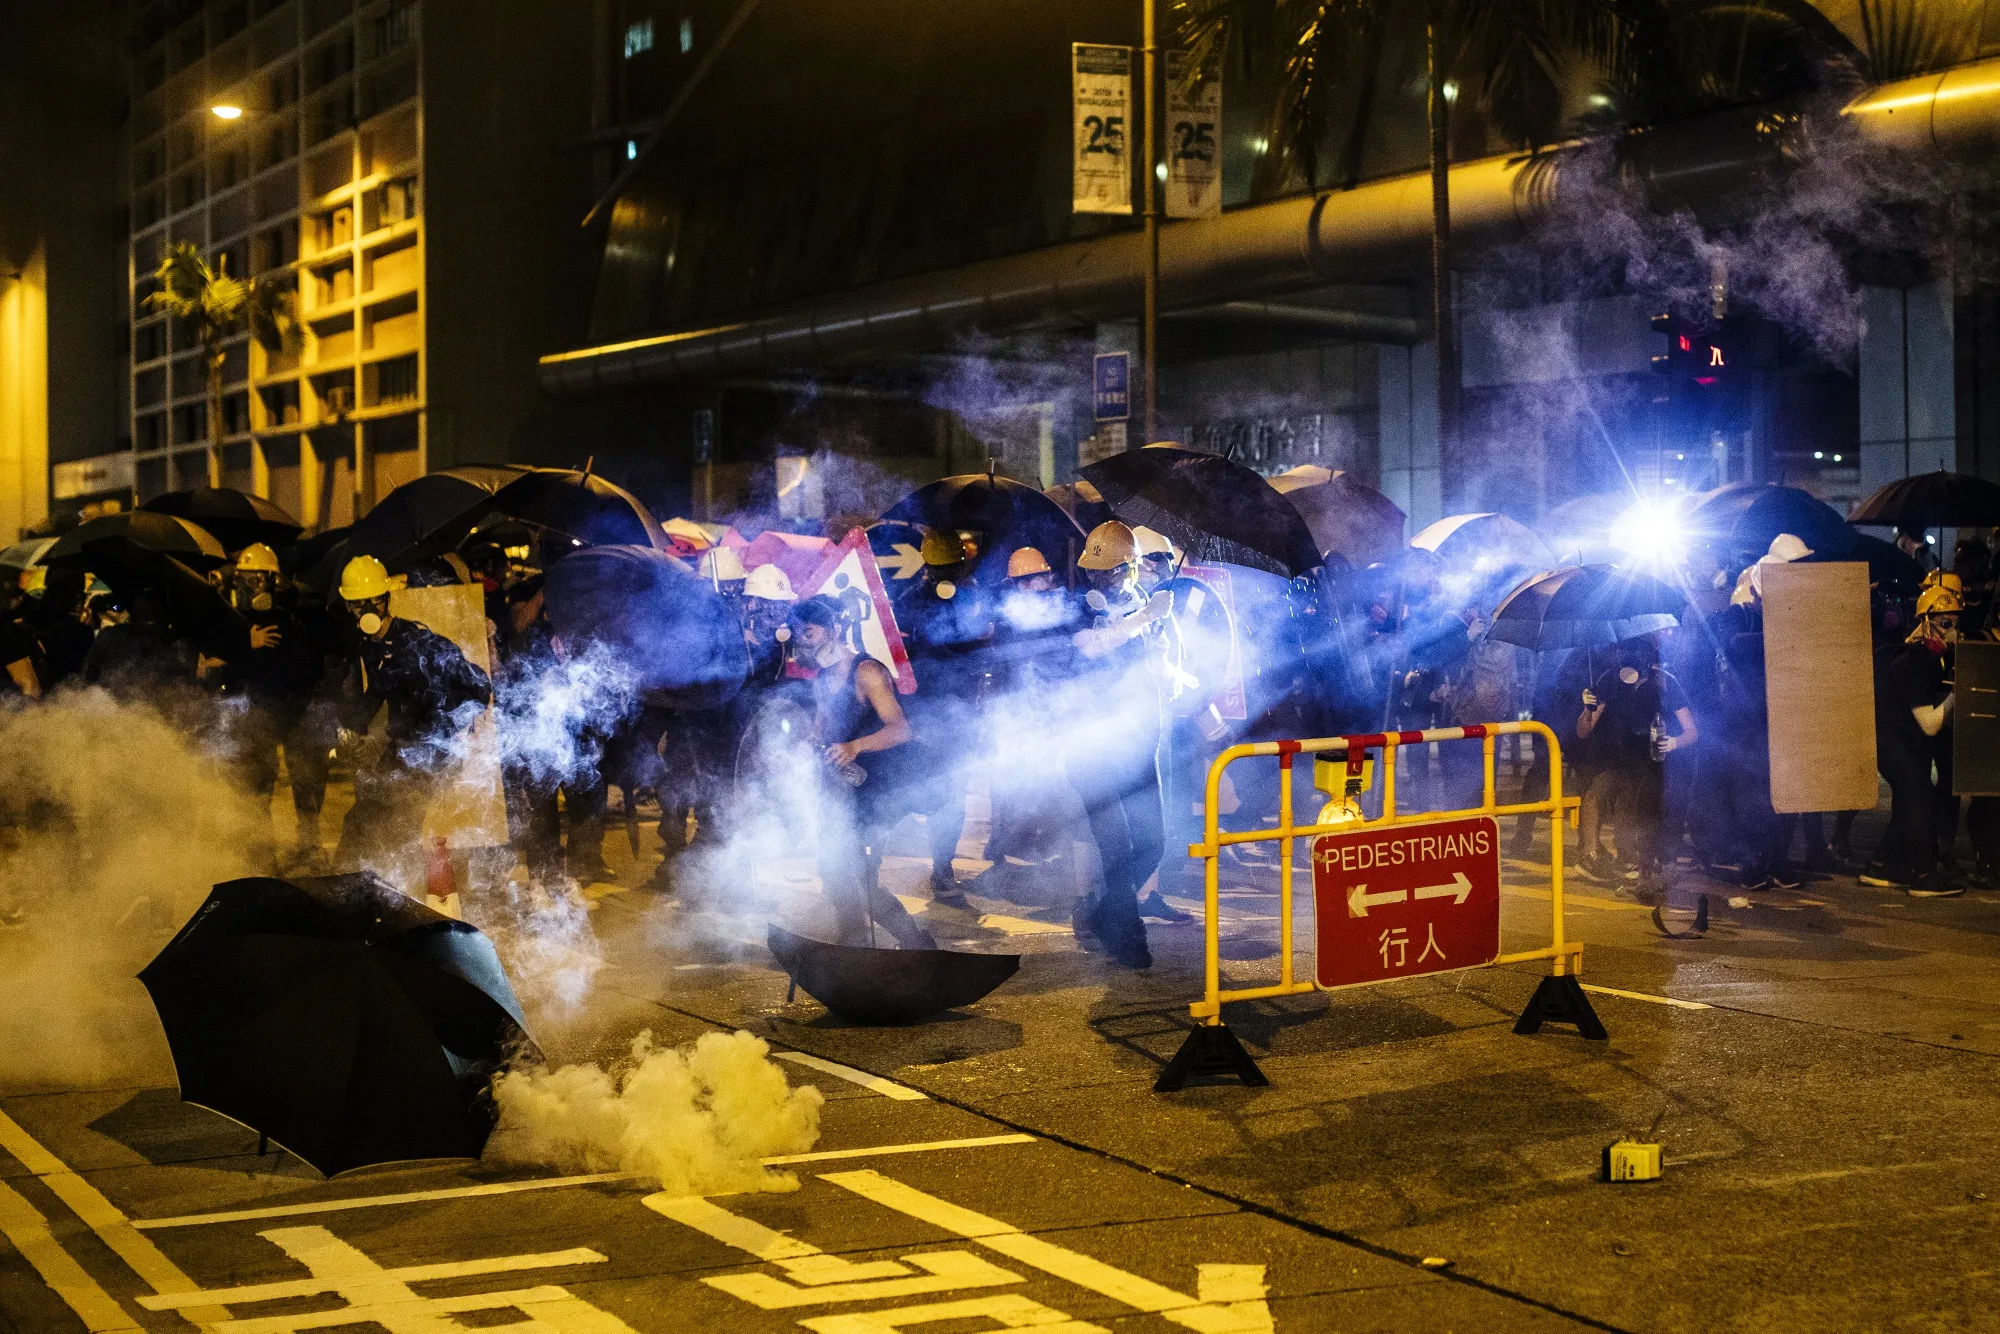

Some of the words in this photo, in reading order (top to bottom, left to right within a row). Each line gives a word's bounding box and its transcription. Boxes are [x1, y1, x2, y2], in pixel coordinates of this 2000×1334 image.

[1082, 115, 1124, 155] 25
[1174, 121, 1215, 161] 25
[1325, 831, 1490, 873] PEDESTRIANS
[1378, 922, 1447, 969] 行人
